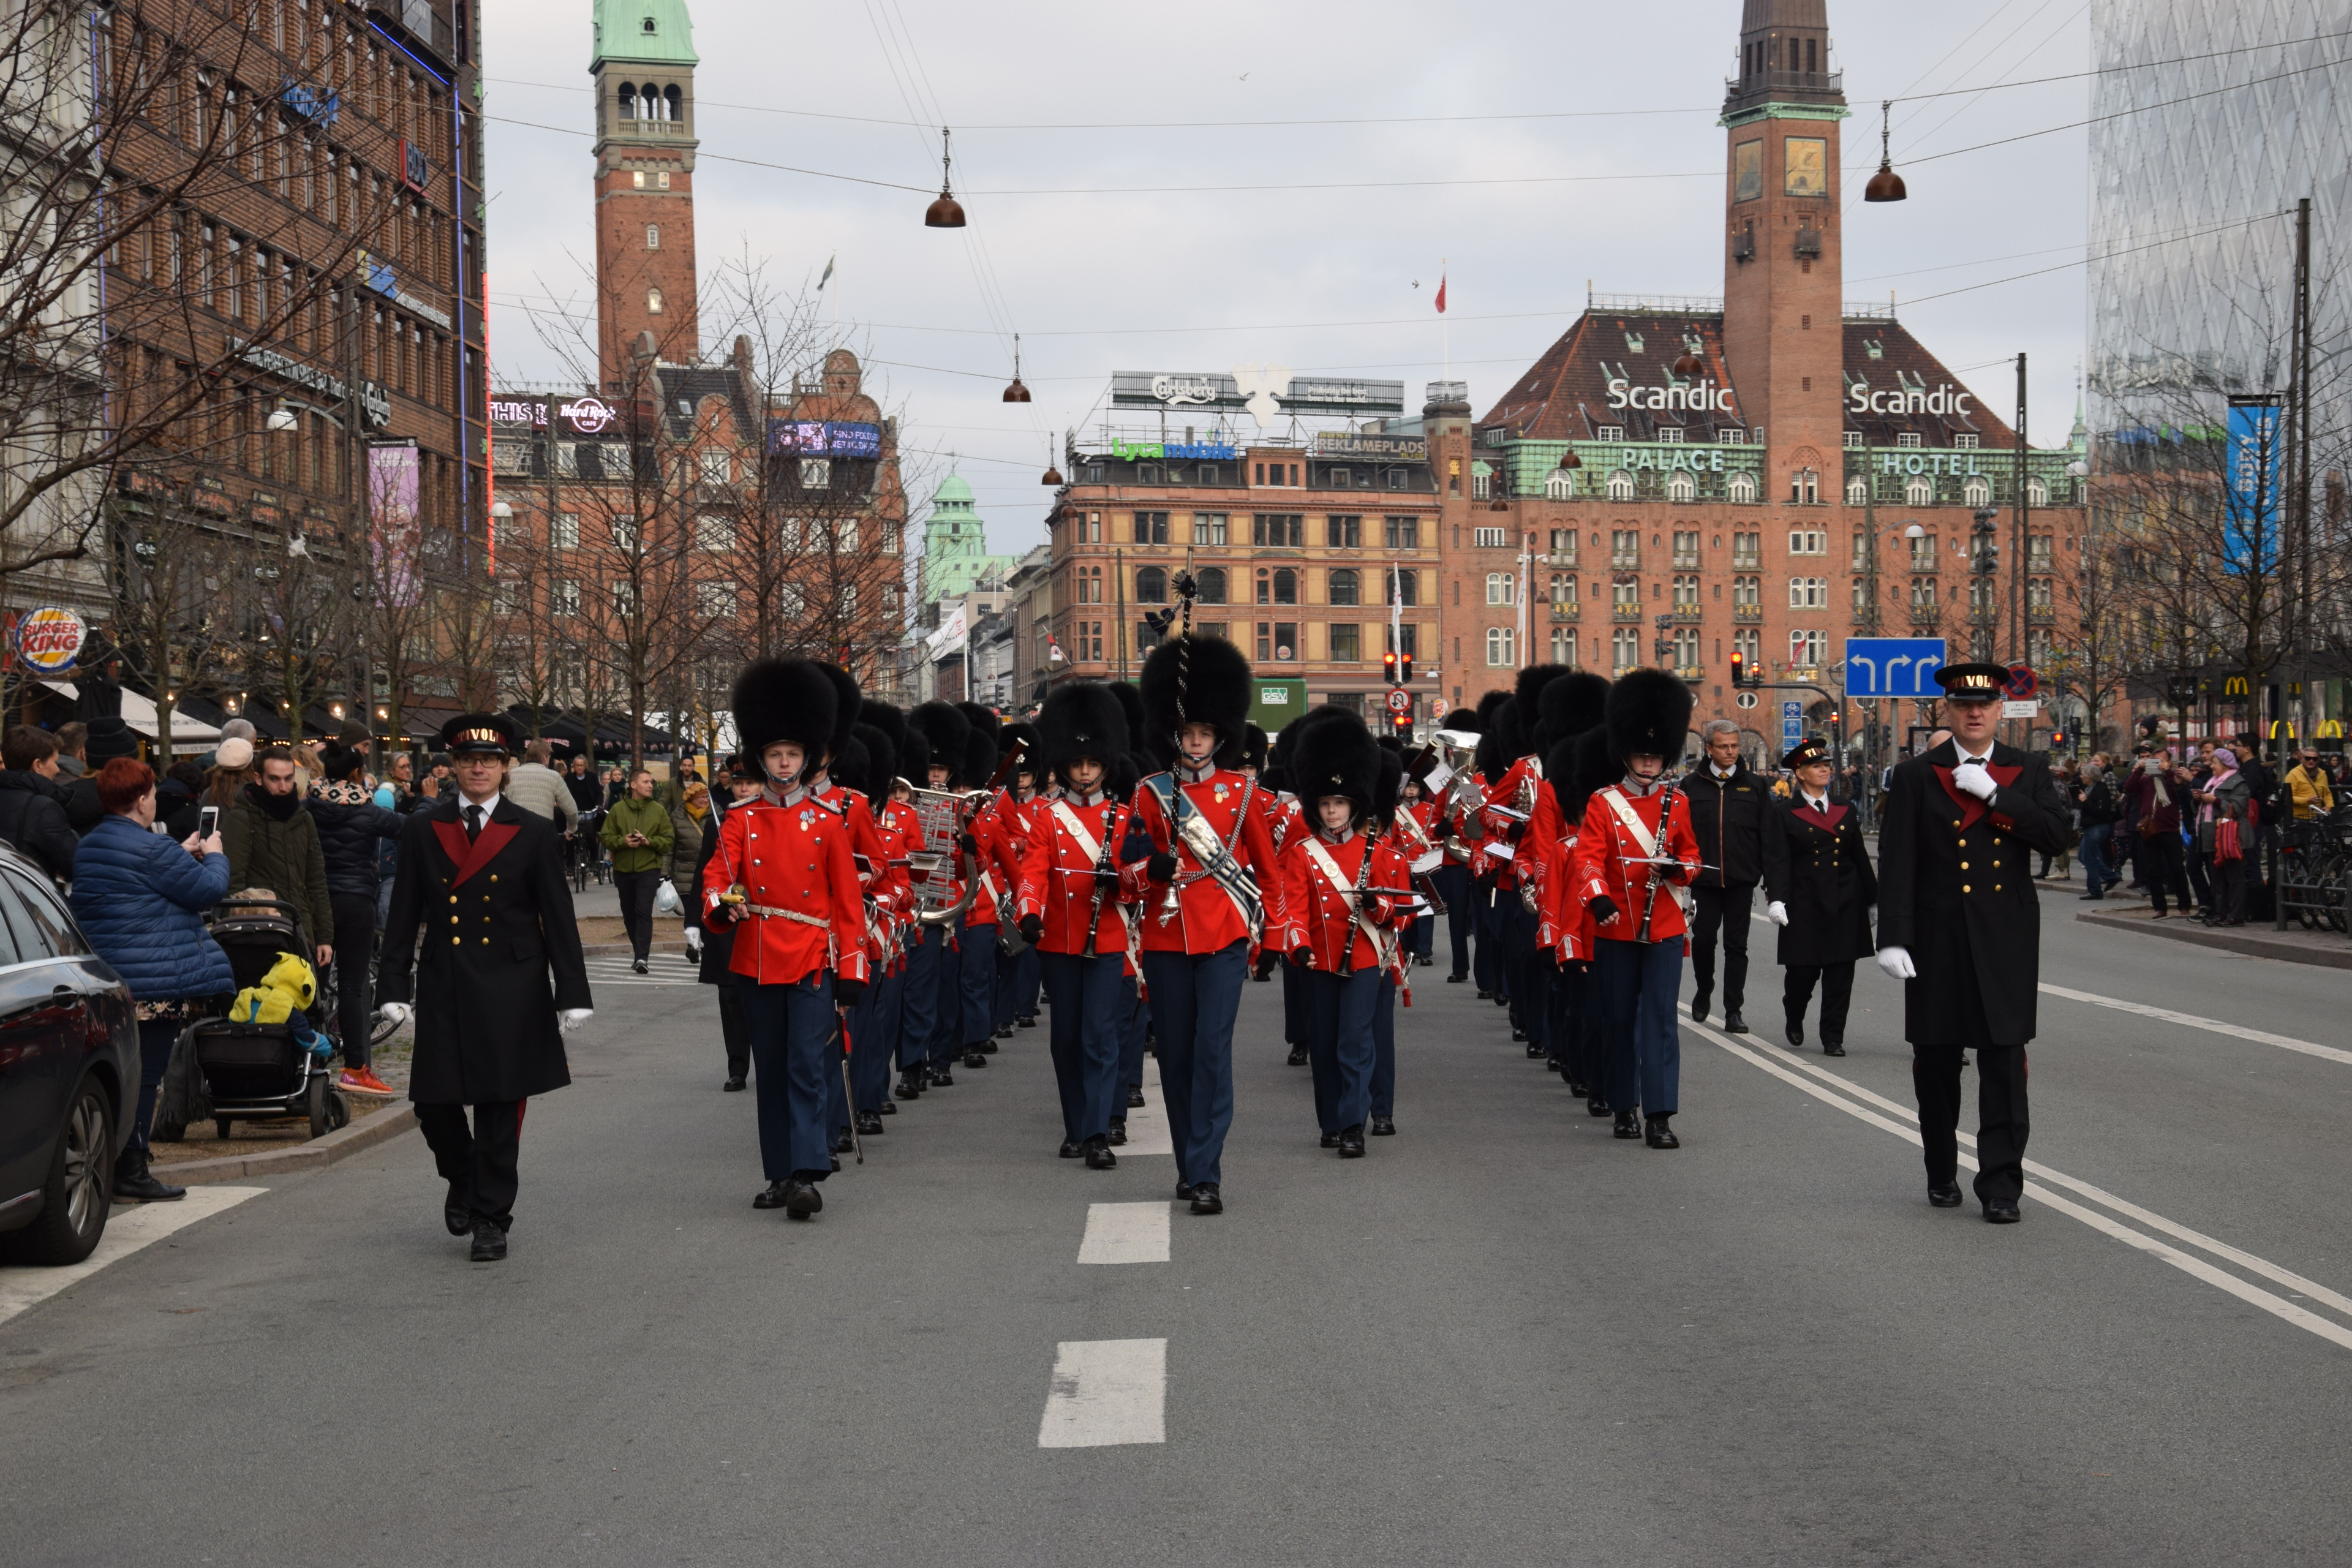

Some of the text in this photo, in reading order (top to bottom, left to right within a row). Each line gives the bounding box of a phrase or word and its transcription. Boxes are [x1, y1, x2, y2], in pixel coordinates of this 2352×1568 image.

[1152, 375, 1216, 405] Carlsberg
[1308, 386, 1340, 396] Probably
[1608, 379, 1733, 410] Scandic
[1850, 383, 1971, 415] Scandic
[560, 404, 616, 420] Hard Rock
[1112, 437, 1236, 461] Lycamobile
[1319, 438, 1425, 454] REKLAMEPLADS
[1623, 448, 1723, 471] PALACE
[1883, 453, 1980, 475] HOTEL
[2239, 434, 2255, 491] BODY
[24, 623, 78, 637] BURGER
[22, 635, 78, 654] KING
[1953, 674, 1993, 688] TIVOLI
[458, 728, 499, 743] TIVOLI
